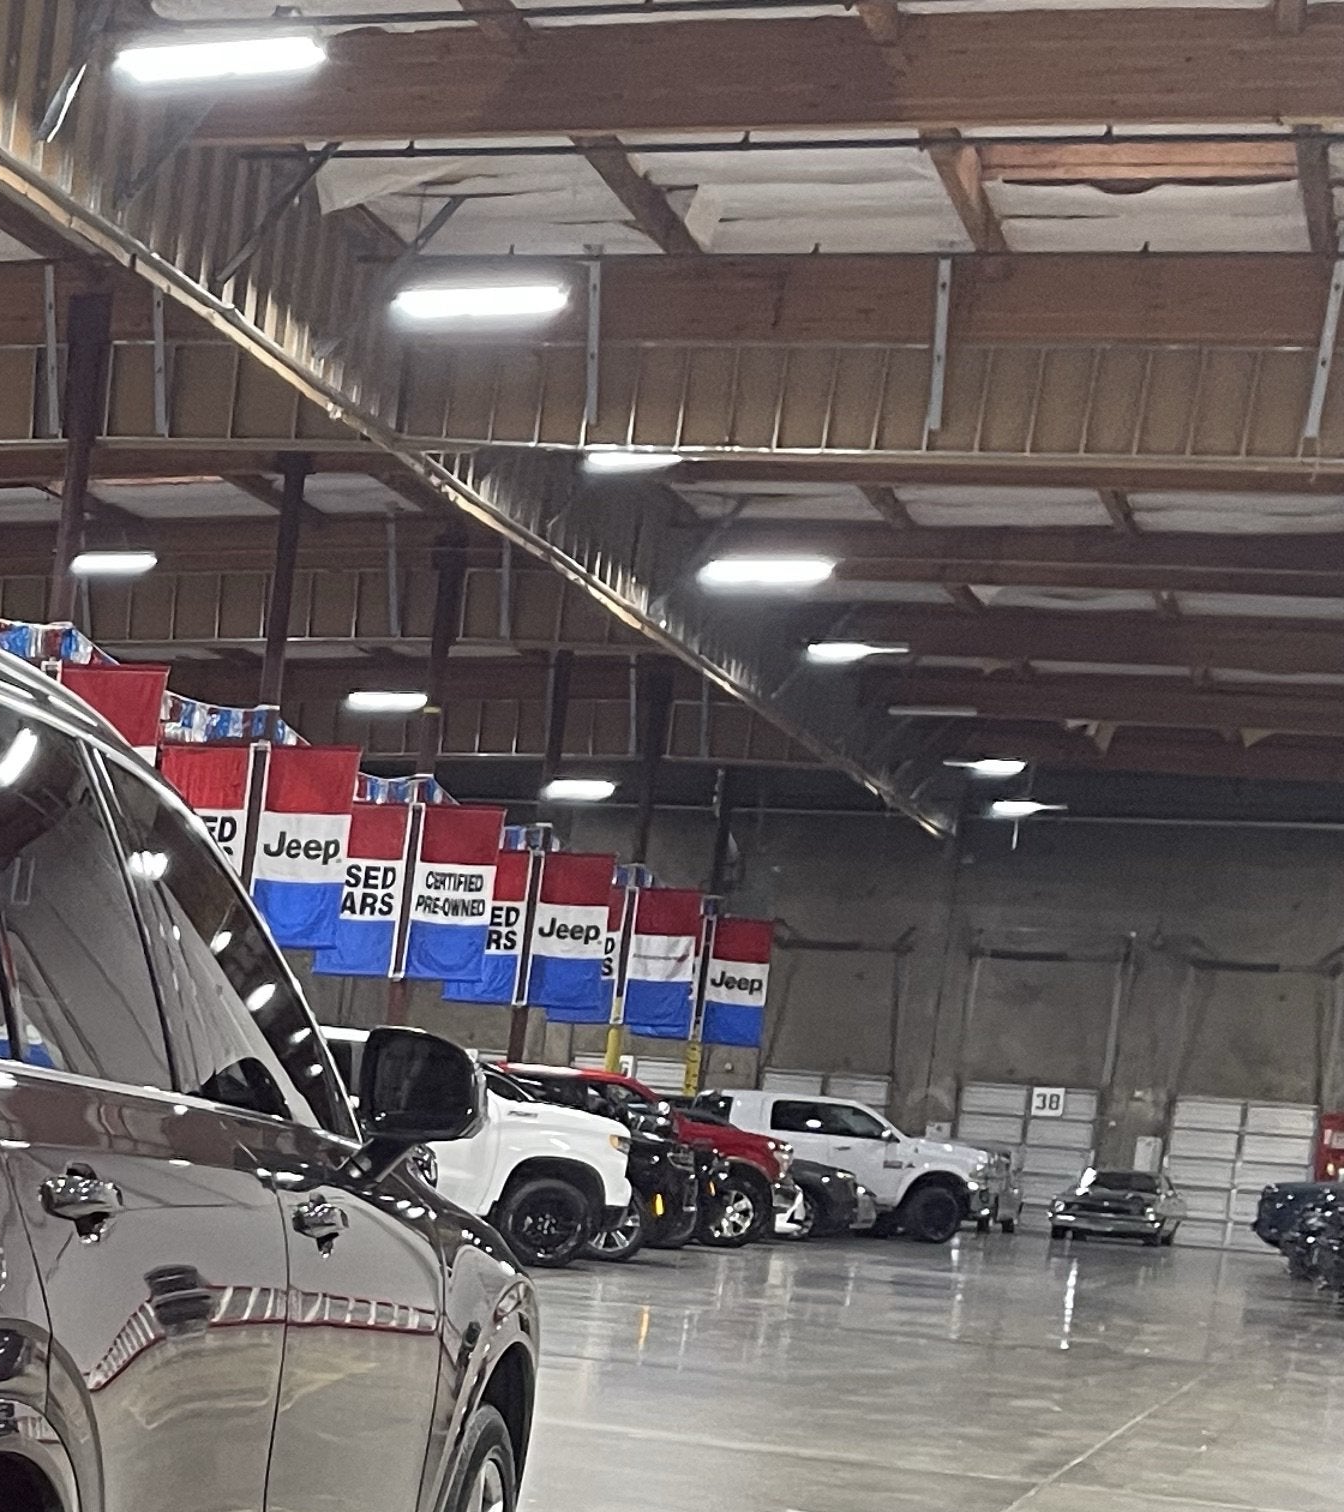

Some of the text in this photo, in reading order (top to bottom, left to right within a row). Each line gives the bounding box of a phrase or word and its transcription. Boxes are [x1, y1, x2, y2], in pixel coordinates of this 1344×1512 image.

[263, 831, 340, 865] Jeep
[345, 864, 396, 889] SED
[426, 870, 484, 892] CERTIFIED
[340, 891, 394, 916] ARS
[415, 894, 486, 917] PRE-OWNED
[538, 917, 601, 945] Jeep
[711, 971, 763, 995] Jeep
